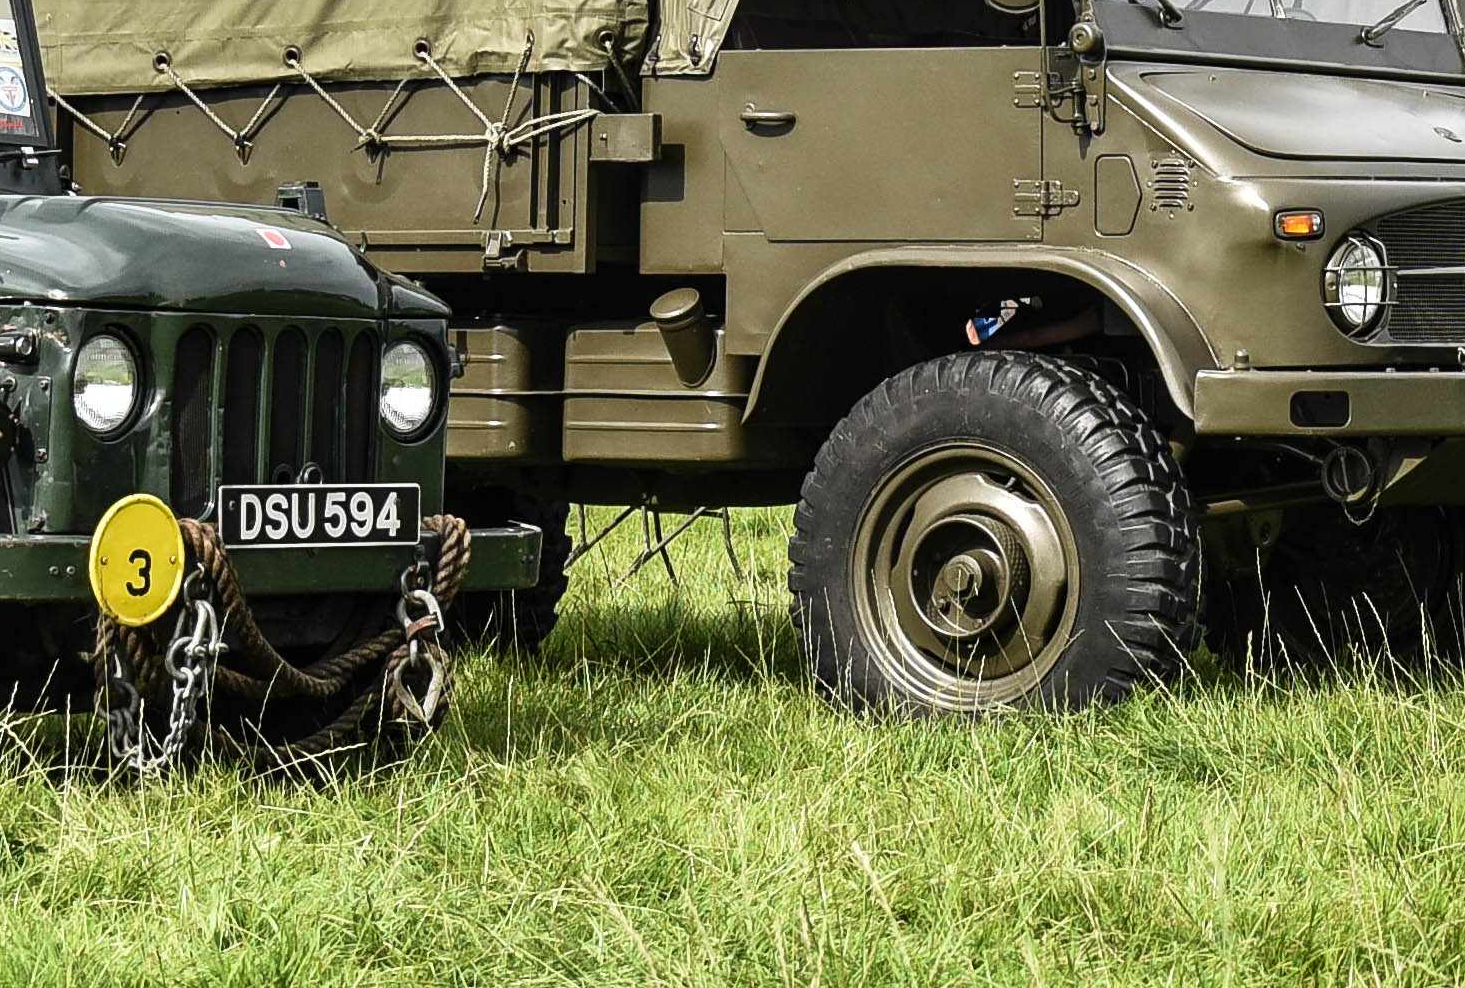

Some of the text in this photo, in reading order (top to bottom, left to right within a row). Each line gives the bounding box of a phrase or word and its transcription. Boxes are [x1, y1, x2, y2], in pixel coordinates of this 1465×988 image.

[240, 491, 401, 540] DSU 594
[126, 549, 152, 597] 3
